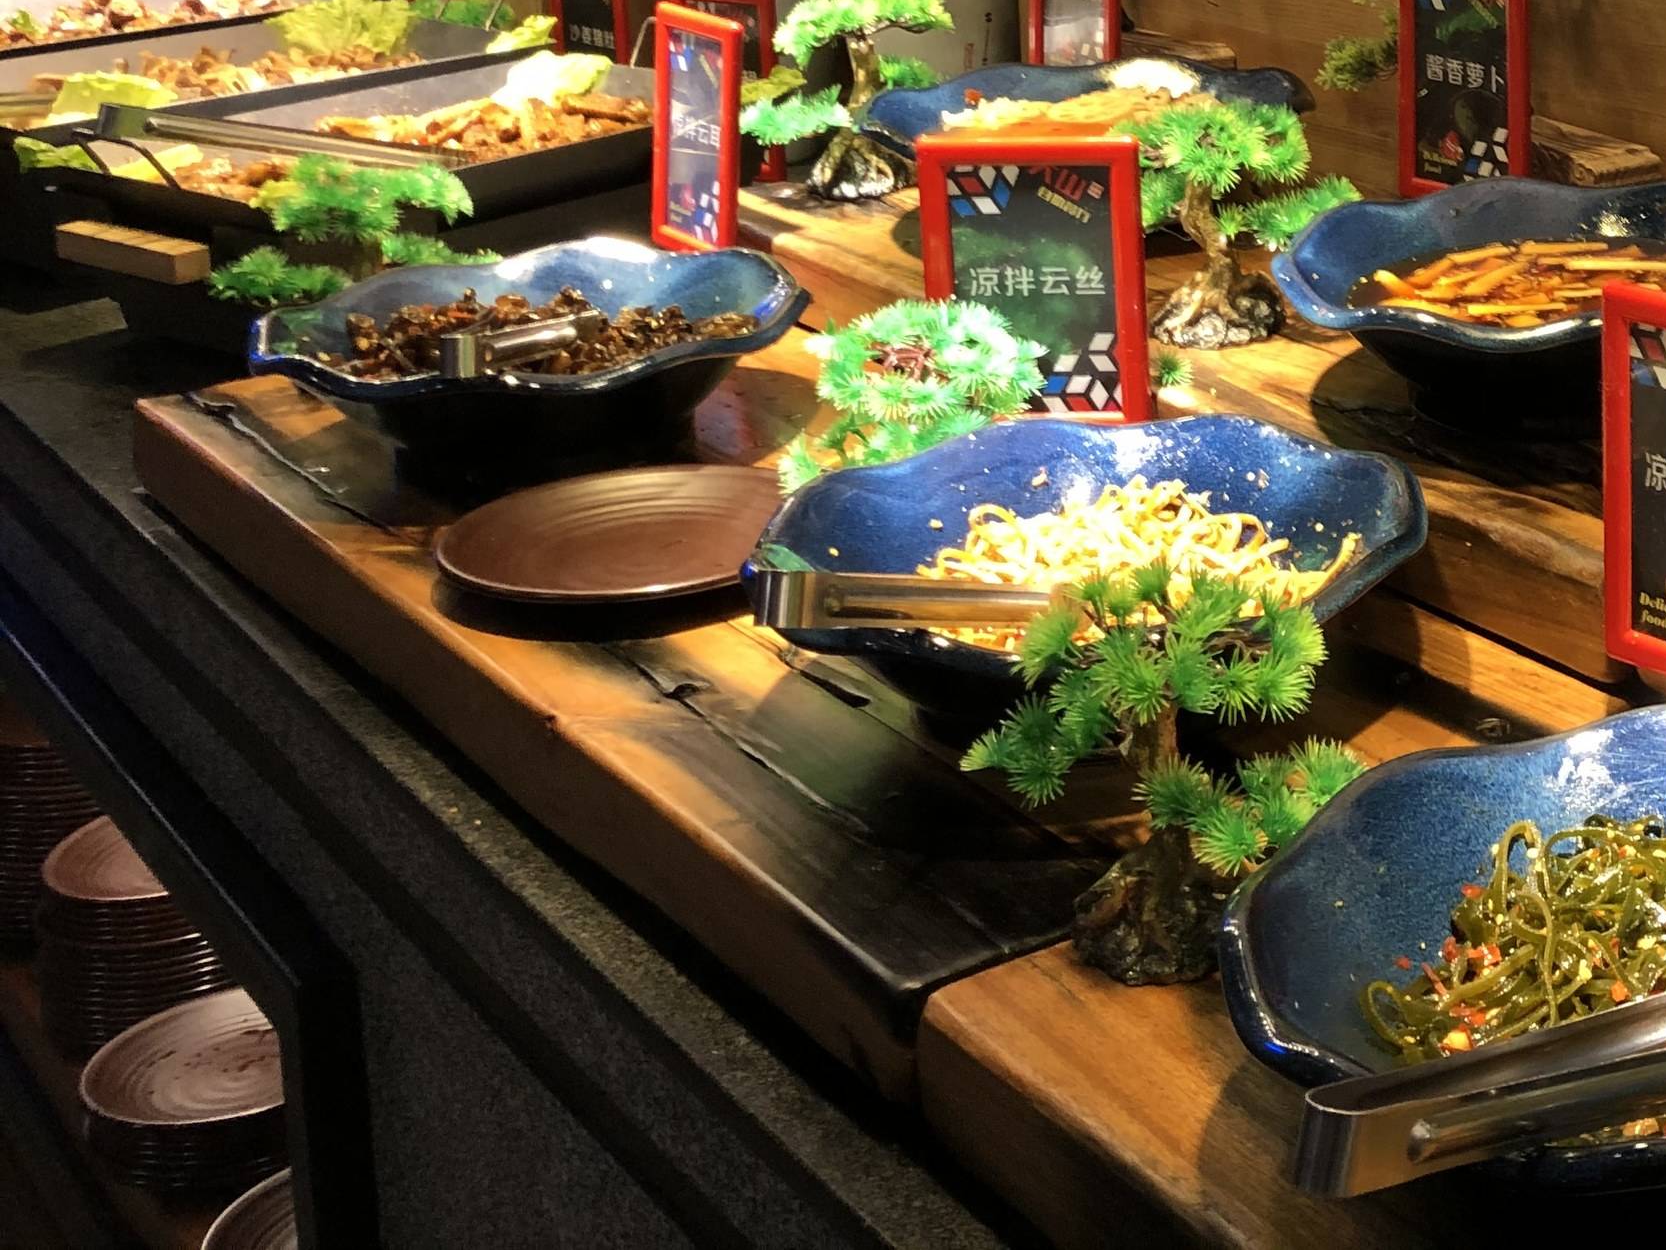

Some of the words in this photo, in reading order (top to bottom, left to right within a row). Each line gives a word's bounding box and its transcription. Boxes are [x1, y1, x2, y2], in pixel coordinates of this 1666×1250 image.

[1424, 52, 1505, 94] 酱香萝卜
[968, 266, 1107, 297] 凉拌云丝
